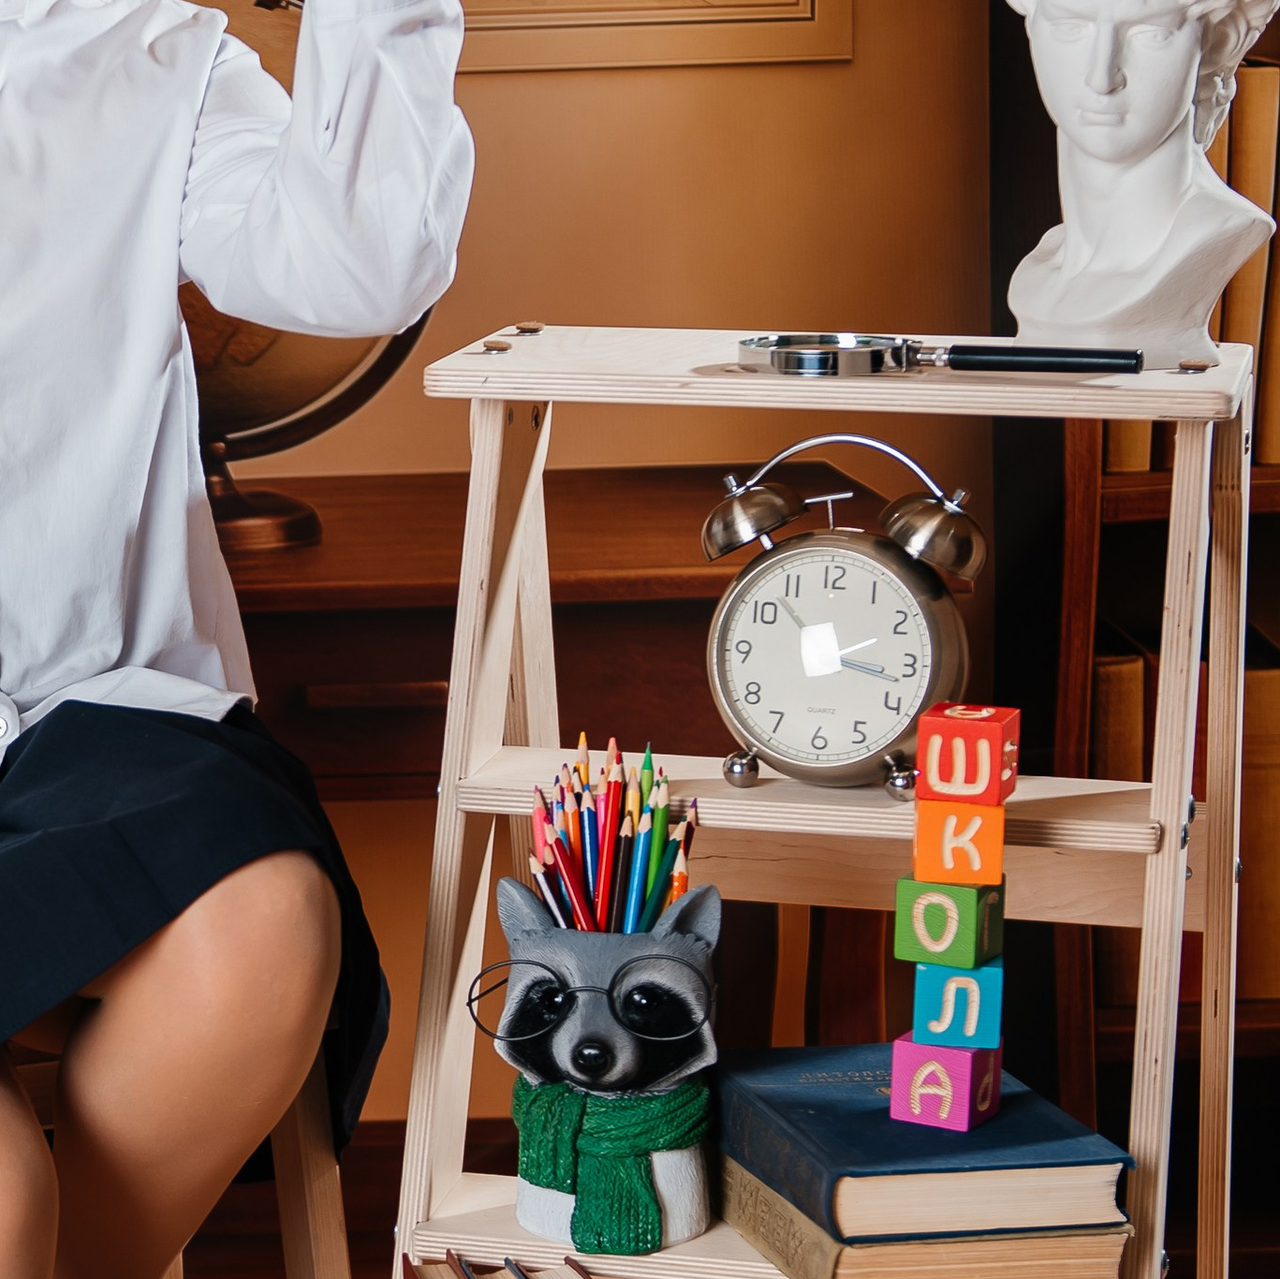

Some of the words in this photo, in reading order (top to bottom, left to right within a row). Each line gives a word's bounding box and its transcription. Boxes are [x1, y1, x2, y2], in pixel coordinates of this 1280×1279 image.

[785, 573, 800, 598] 11
[823, 565, 846, 590] 12
[871, 580, 878, 604] 1
[753, 599, 778, 624] 10
[893, 610, 908, 635] 2
[735, 639, 752, 664] 9
[901, 653, 917, 678] 3
[744, 681, 761, 705] 8
[883, 690, 902, 715] 4
[768, 710, 785, 734] 7
[806, 705, 837, 715] QUARTZ
[810, 726, 828, 750] 6
[851, 720, 867, 745] 5
